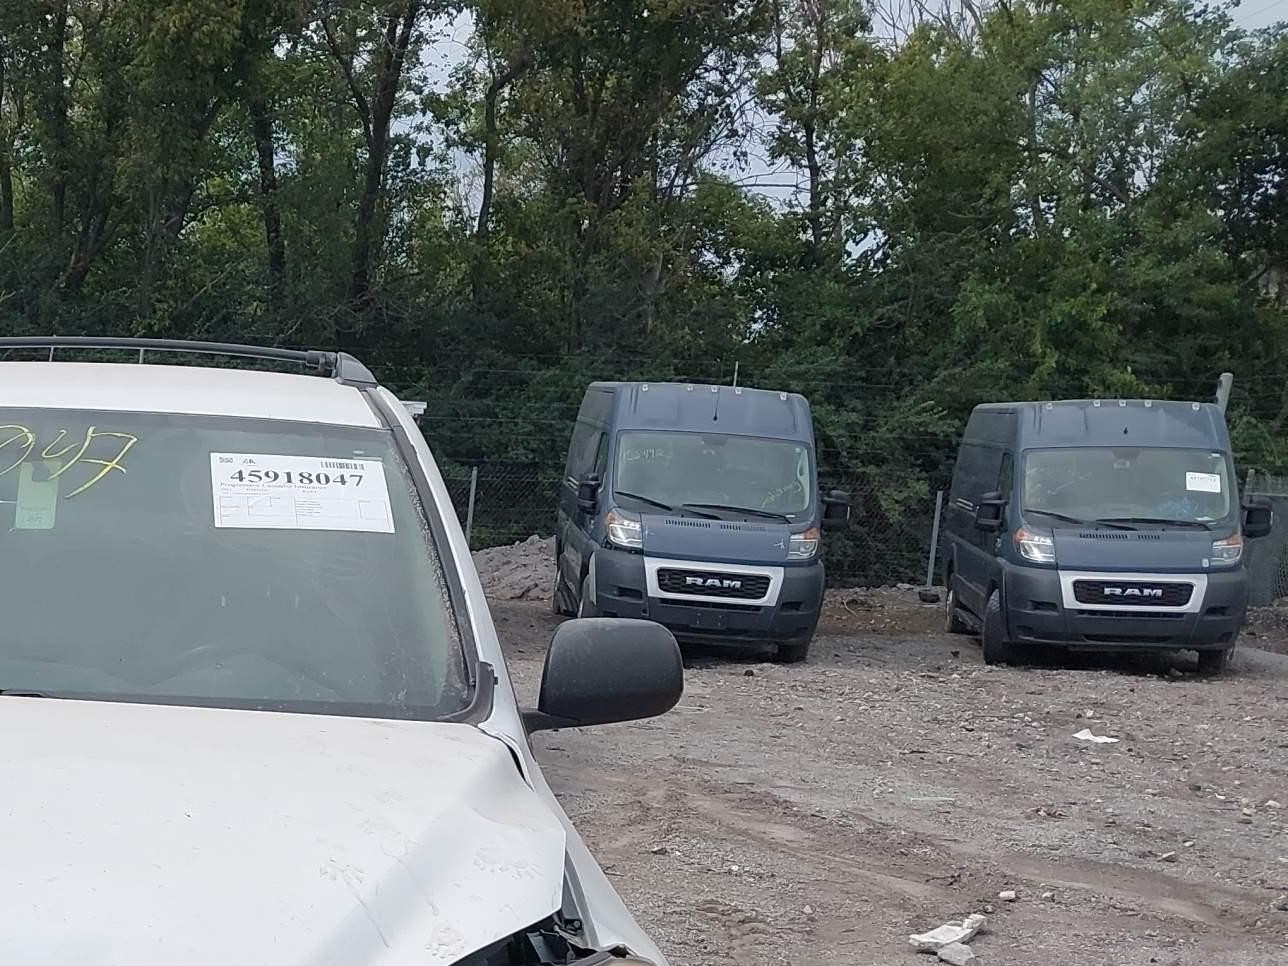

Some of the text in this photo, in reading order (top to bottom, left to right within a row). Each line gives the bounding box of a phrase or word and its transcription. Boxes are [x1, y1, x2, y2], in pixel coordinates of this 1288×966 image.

[230, 469, 364, 487] 45918047
[685, 576, 742, 589] RAM
[1103, 587, 1163, 598] RAM
